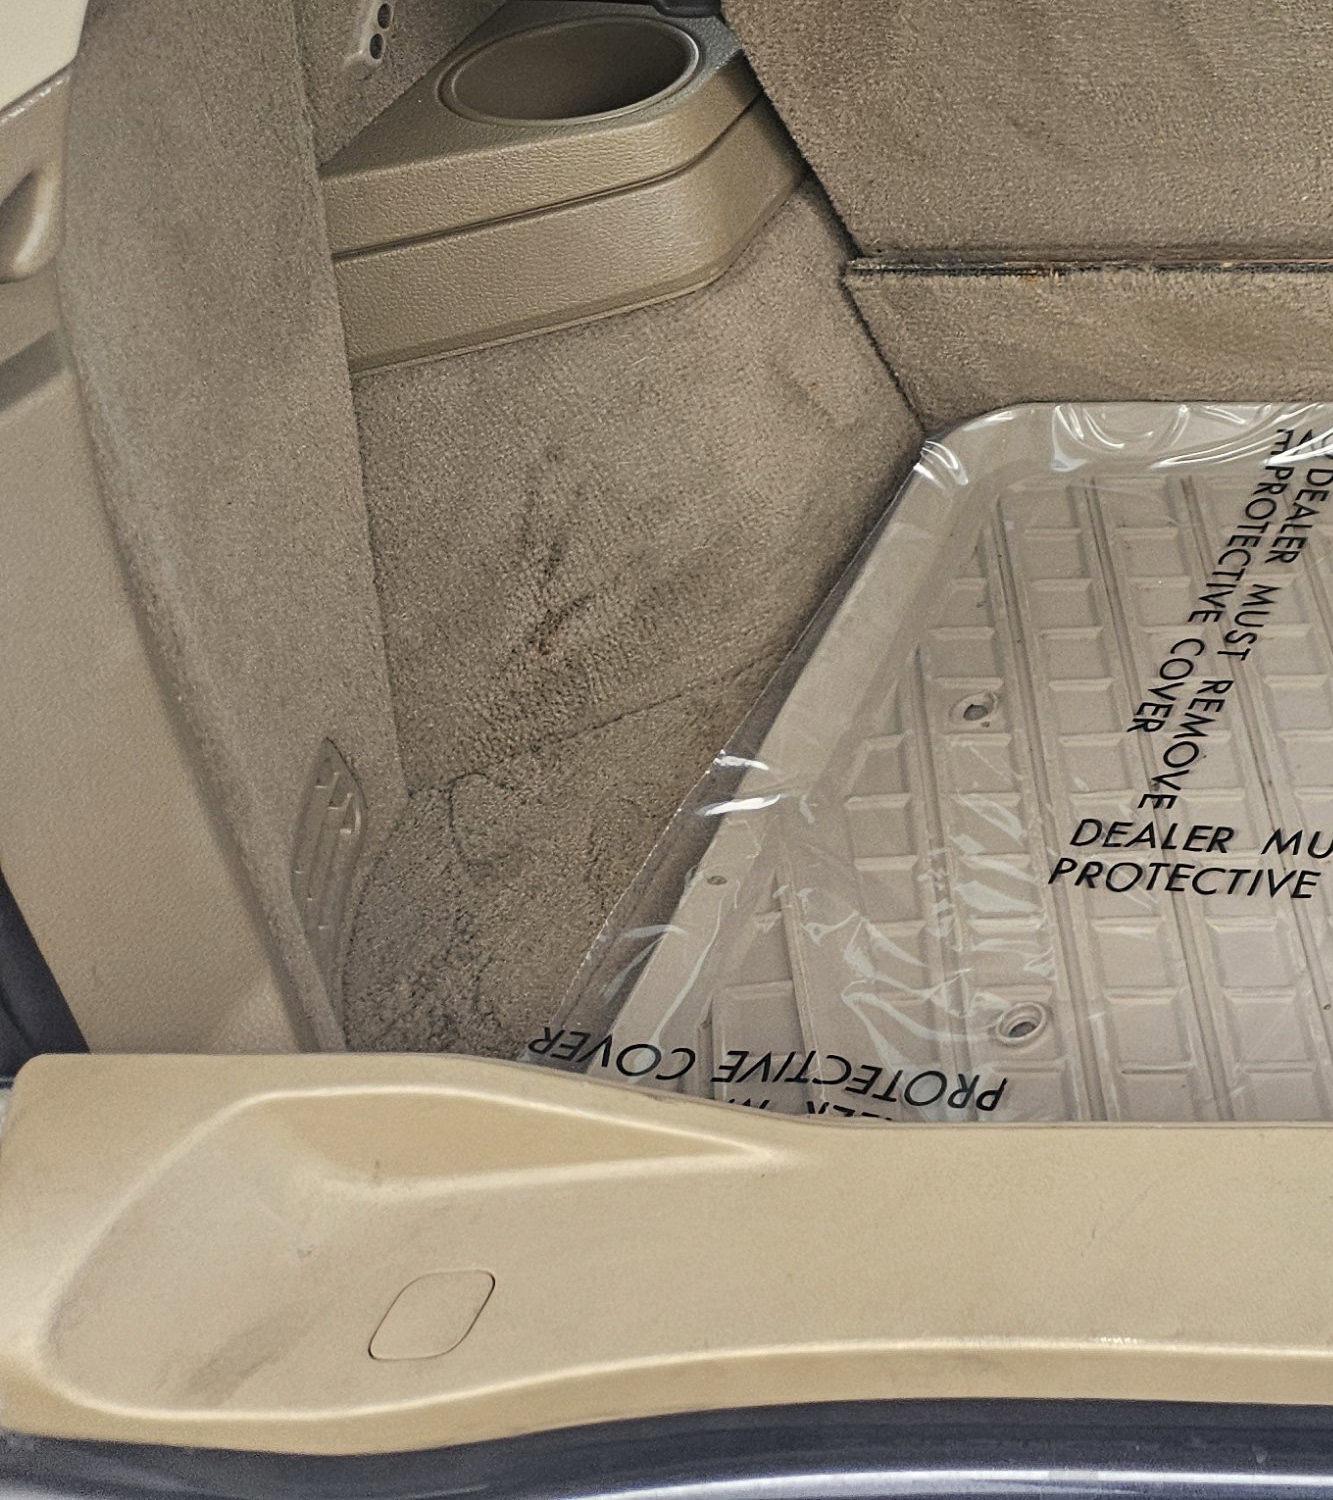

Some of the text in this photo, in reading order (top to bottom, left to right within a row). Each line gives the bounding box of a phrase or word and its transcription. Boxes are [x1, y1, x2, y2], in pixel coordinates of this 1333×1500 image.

[1127, 465, 1295, 733] PROTECTIVE COVER
[1217, 583, 1283, 662] MUST
[1137, 679, 1235, 810] REMOVE
[1069, 818, 1236, 853] DEALER
[1047, 857, 1322, 900] PROTECTIVE
[527, 1026, 697, 1080] COVER
[711, 1049, 1008, 1112] PROTECTIVE
